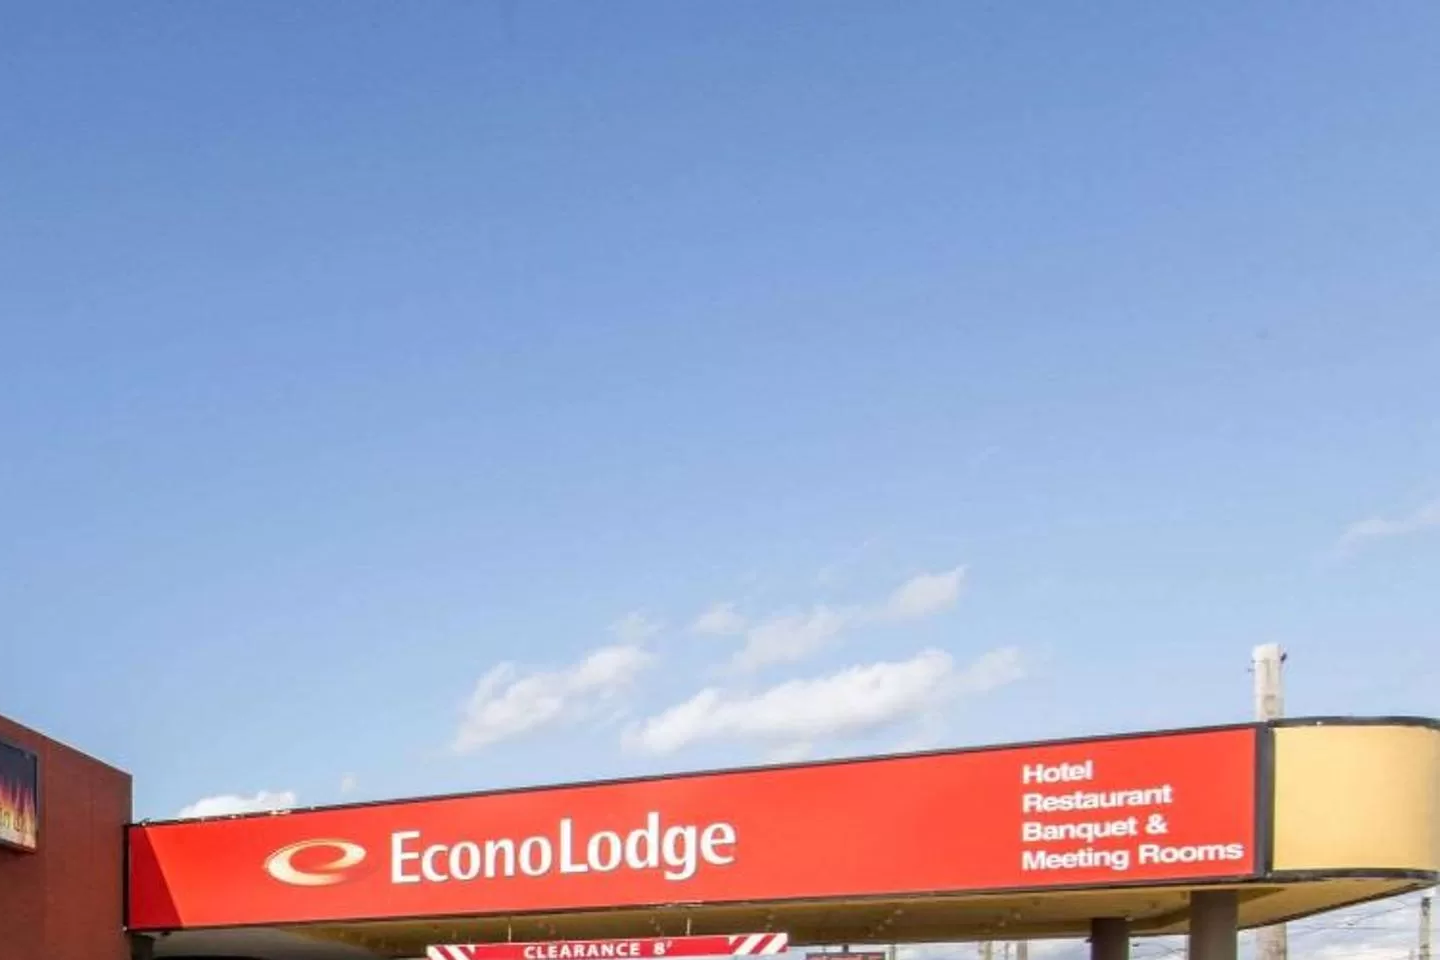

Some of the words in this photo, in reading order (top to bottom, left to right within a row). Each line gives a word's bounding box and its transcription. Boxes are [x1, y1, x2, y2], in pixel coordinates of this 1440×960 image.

[1022, 760, 1094, 785] Hotel
[1022, 784, 1173, 813] Restaurant
[1022, 815, 1138, 842] Banquet
[1145, 812, 1168, 834] &
[1022, 847, 1130, 871] Meeting
[1138, 842, 1244, 865] Rooms
[523, 941, 641, 960] CLEARANCE
